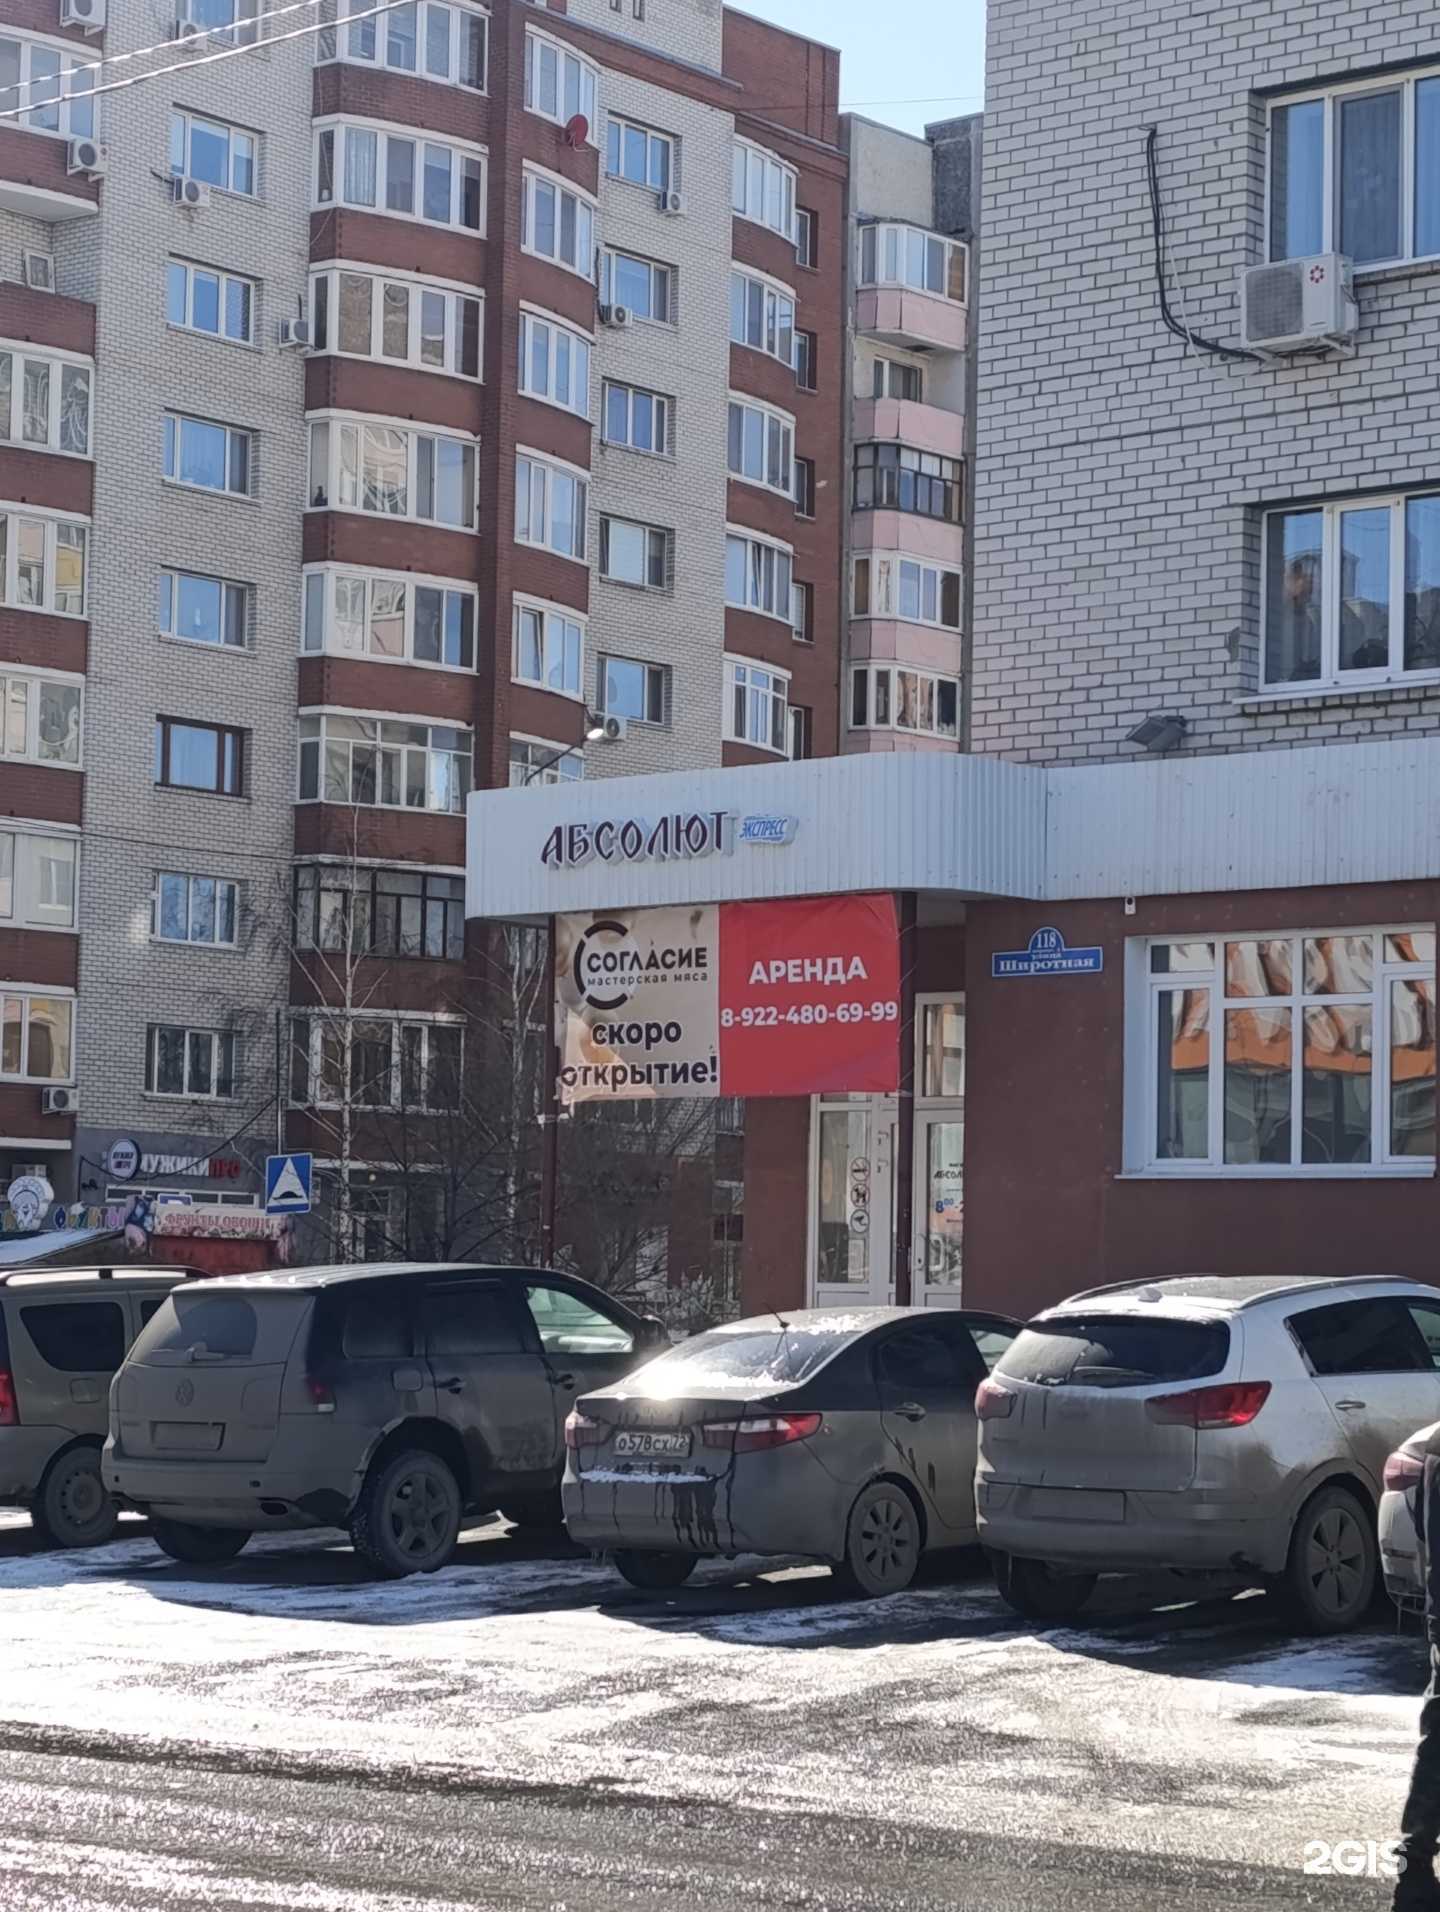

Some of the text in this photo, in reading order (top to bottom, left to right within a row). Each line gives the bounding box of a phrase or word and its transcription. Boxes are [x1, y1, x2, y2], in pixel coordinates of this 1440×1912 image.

[541, 811, 788, 865] АБСОЛЮТ ЭКСПРЕСС
[1037, 931, 1057, 949] 118
[587, 947, 708, 973] СОГЛАСИЕ
[749, 956, 868, 986] АРЕНДА
[1000, 957, 1095, 974] Широтная
[587, 972, 708, 987] мастерская мяса
[720, 1001, 898, 1028] 8-922-480-69-99
[592, 1021, 682, 1051] скоро
[561, 1055, 718, 1092] открытие!
